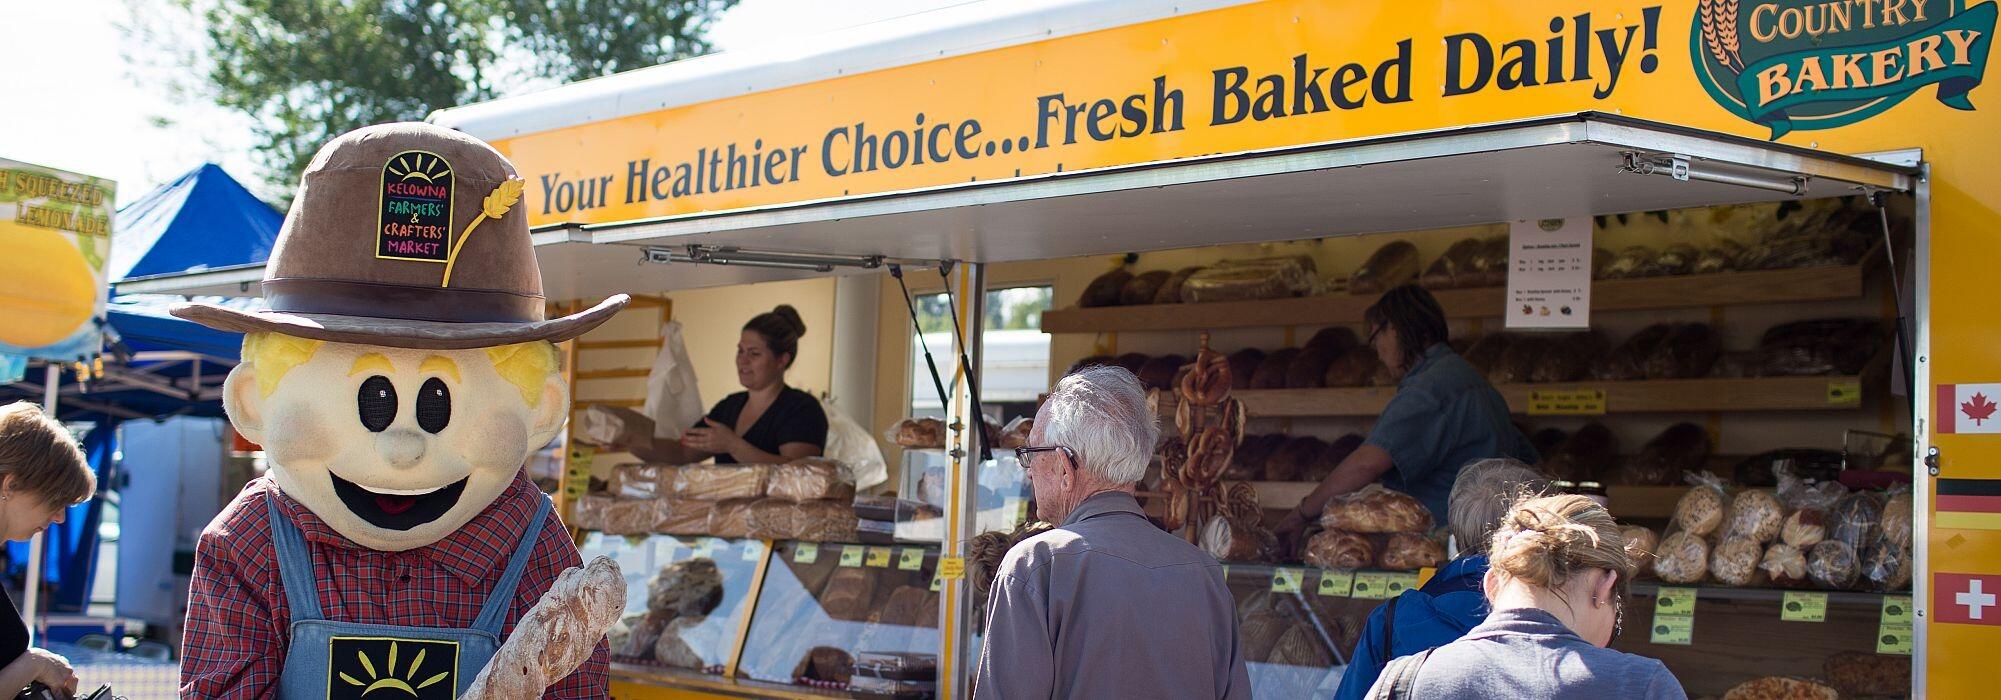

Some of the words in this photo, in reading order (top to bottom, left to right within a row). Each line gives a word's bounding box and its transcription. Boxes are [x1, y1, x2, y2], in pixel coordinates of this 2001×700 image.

[1749, 0, 1928, 43] COUNTRY
[1755, 29, 1982, 107] BAKERY
[540, 174, 614, 215] Your
[624, 138, 808, 204] Healthier
[1209, 37, 1413, 127] Baked
[1441, 5, 1663, 100] Daily!
[15, 172, 104, 207] SQUEEZED
[387, 182, 447, 198] KELOWNA
[15, 201, 109, 236] LEMONADE
[388, 200, 444, 217] FARMERS'
[410, 212, 420, 224] &
[383, 222, 446, 239] CRAFTERS'
[387, 240, 439, 255] MARKET
